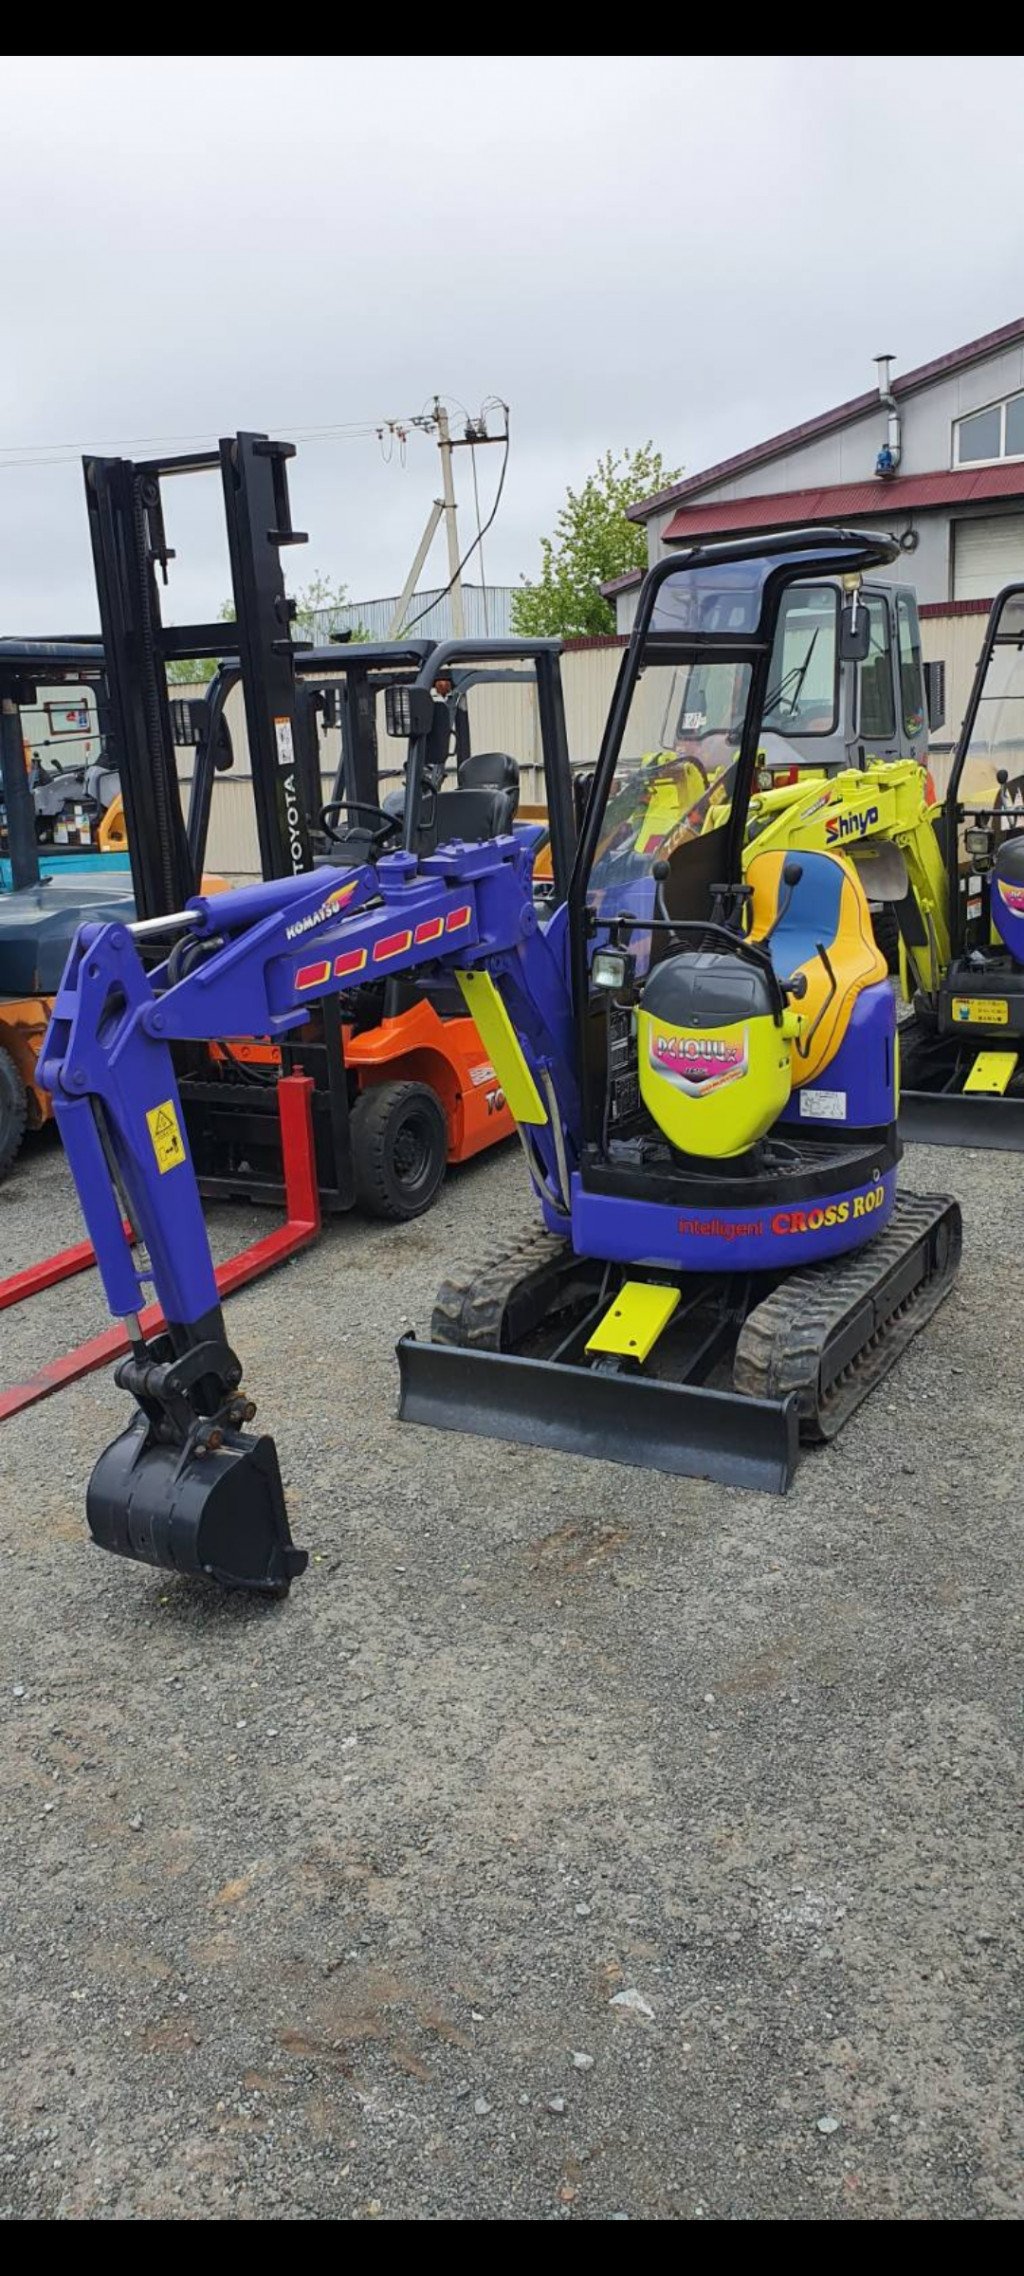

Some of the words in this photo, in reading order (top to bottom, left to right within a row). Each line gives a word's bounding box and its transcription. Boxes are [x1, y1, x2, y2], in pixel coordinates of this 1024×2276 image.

[283, 774, 304, 876] TOYOTA
[825, 806, 879, 844] Shinyo
[286, 901, 341, 940] KOMATSU
[678, 1217, 763, 1242] intelligent
[771, 1202, 849, 1237] CROSS
[853, 1186, 885, 1218] ROD
